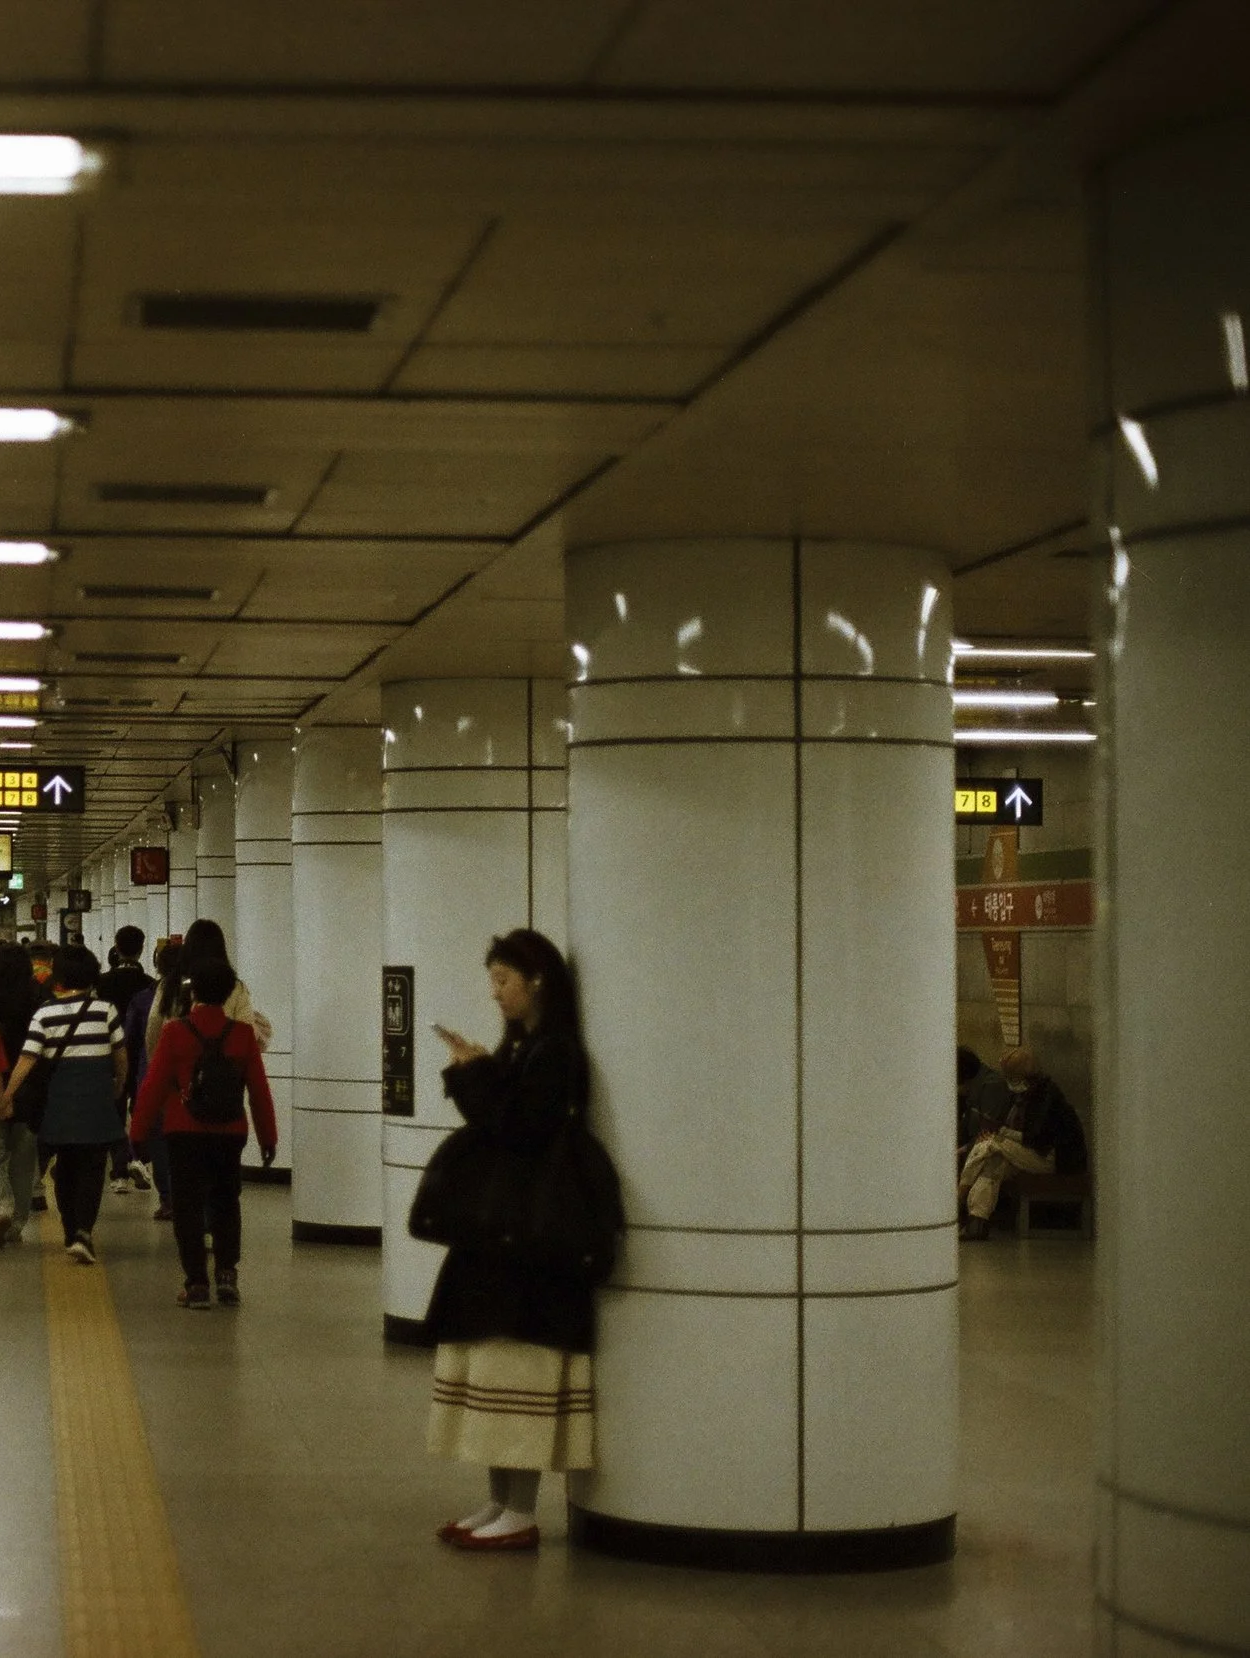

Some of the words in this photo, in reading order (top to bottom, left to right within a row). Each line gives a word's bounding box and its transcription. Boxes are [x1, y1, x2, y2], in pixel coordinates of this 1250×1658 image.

[9, 775, 16, 785] 3
[26, 776, 33, 785] 4
[9, 793, 16, 803] 7
[26, 793, 33, 804] 8
[960, 794, 969, 808] 7
[981, 794, 991, 808] 8
